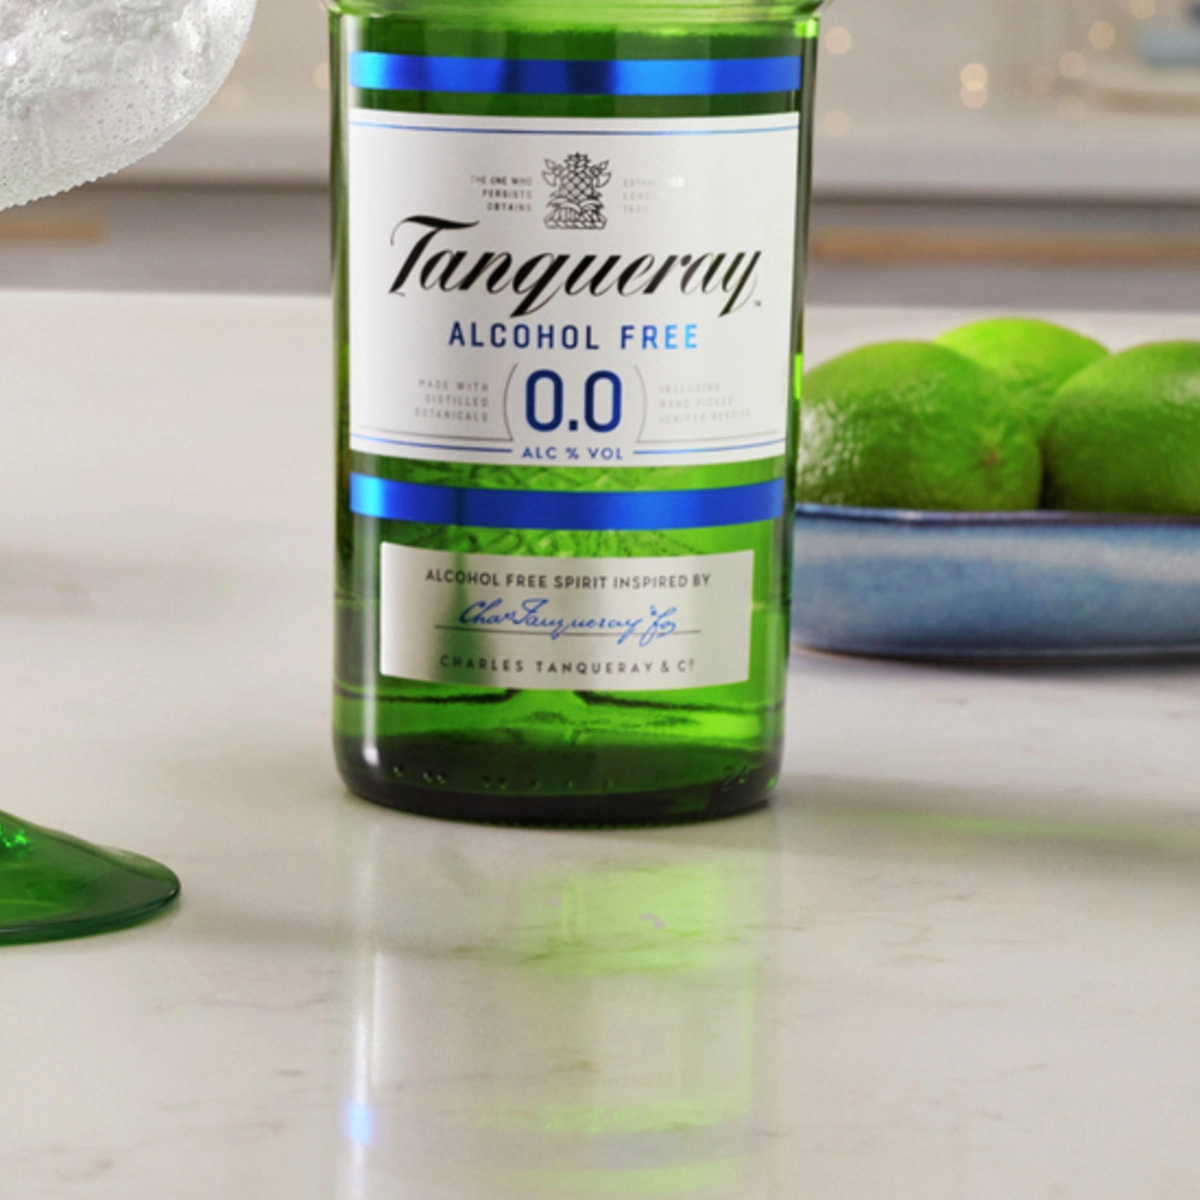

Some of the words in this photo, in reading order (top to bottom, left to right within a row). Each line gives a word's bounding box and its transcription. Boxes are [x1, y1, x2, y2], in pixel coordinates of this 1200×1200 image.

[388, 215, 761, 318] Tanqueray
[448, 321, 600, 350] ALCOHOL
[620, 323, 699, 350] FREE
[525, 369, 623, 433] 0.0
[521, 446, 557, 460] ALC
[566, 446, 580, 461] %
[588, 446, 624, 460] VOL
[425, 568, 501, 588] ALCOHOL
[505, 572, 549, 589] FREE
[553, 574, 608, 590] SPIRIT
[612, 573, 689, 589] INSPIRED
[691, 572, 711, 587] BY
[439, 653, 525, 673] CHARLES
[535, 659, 653, 676] TANQUERAY
[660, 659, 670, 674] &
